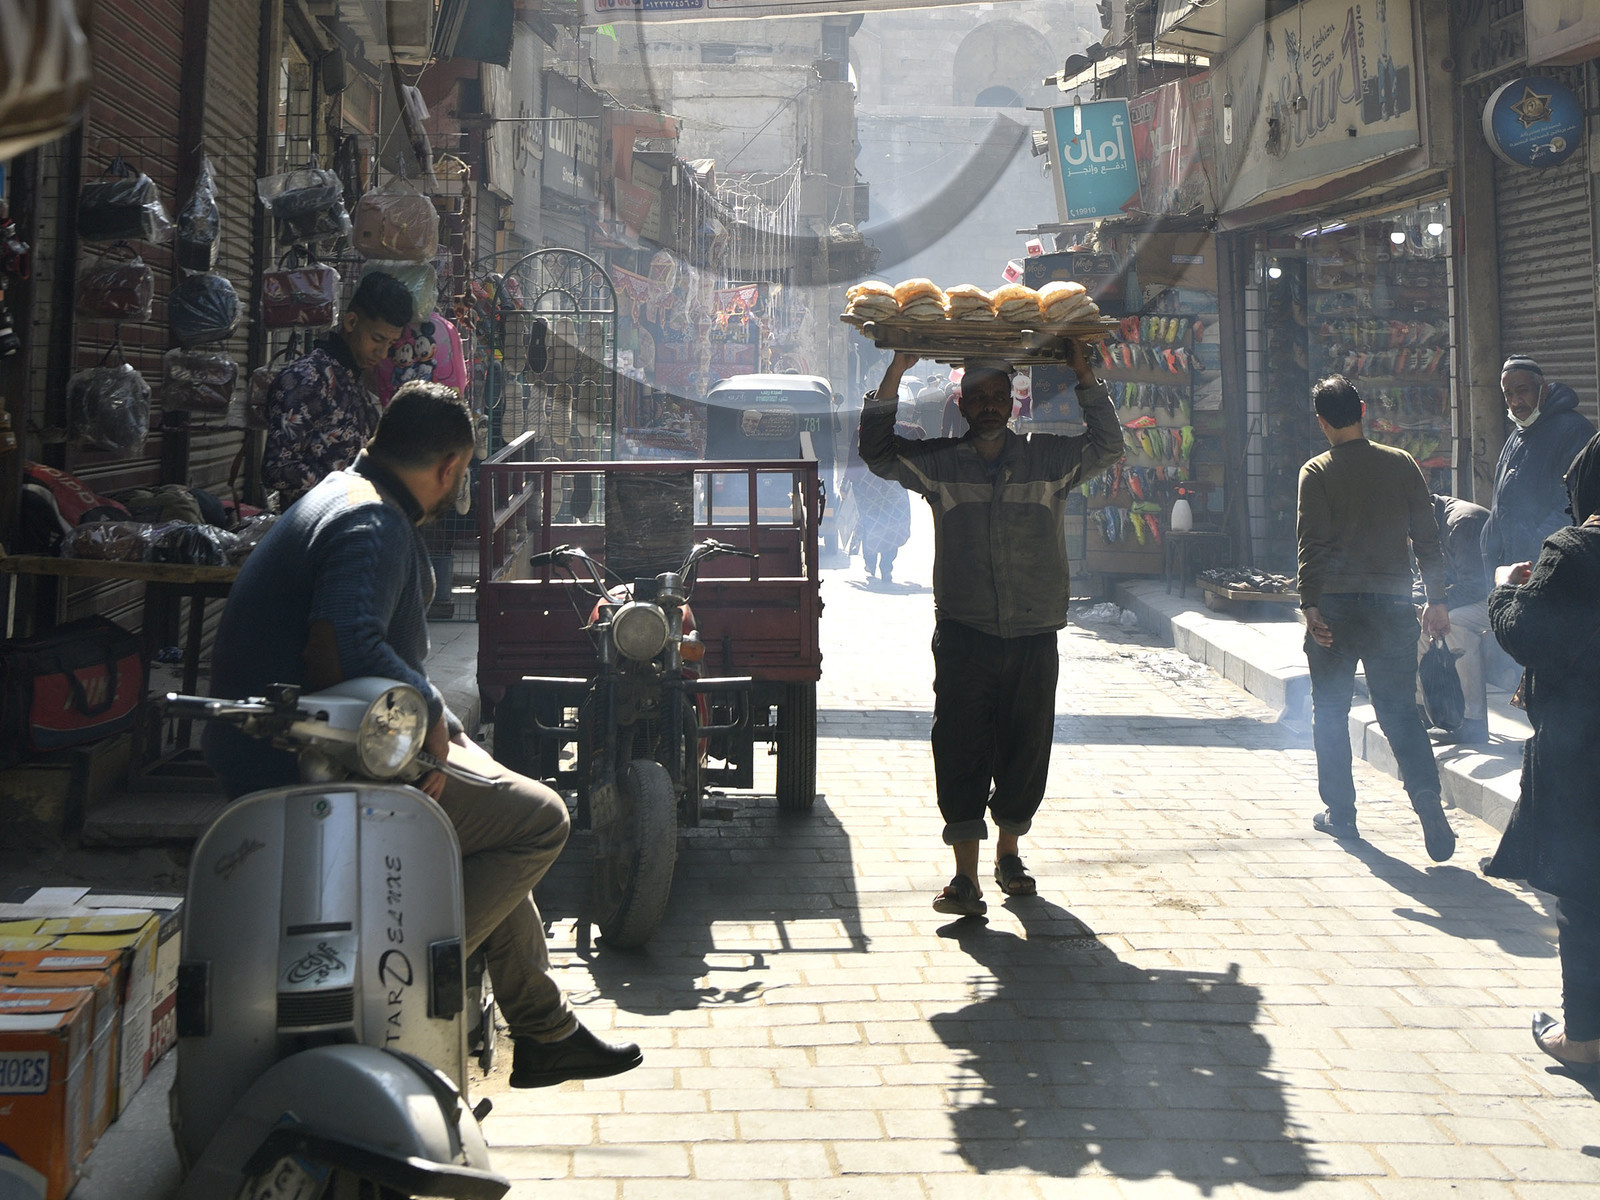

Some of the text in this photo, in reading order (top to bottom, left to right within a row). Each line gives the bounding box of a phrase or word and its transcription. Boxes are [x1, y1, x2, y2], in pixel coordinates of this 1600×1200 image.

[1064, 114, 1126, 166] أمان
[1075, 206, 1096, 215] 19910
[804, 418, 821, 432] 781
